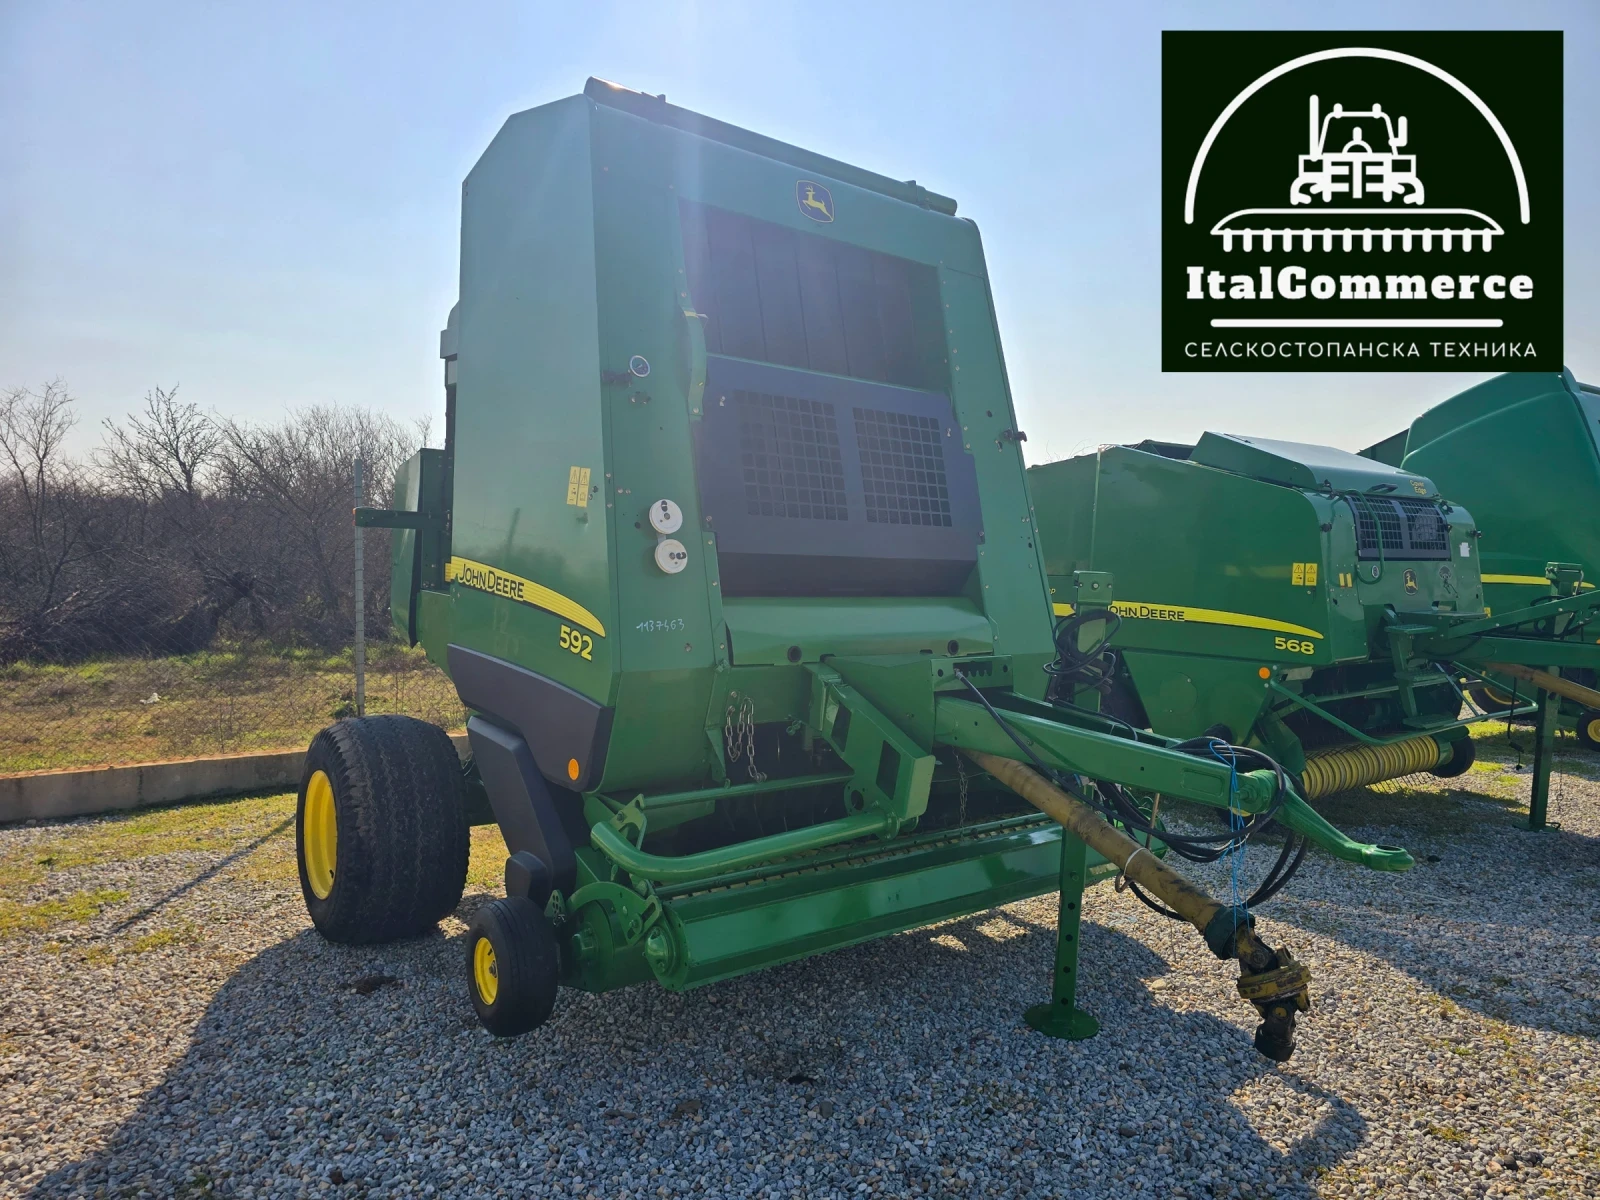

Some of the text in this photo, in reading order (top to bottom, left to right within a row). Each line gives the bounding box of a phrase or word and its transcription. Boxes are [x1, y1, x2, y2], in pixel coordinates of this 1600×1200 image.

[459, 563, 525, 599] JOHN DEERE
[1108, 605, 1185, 620] OHN DEERE
[559, 624, 593, 661] 592
[1274, 637, 1315, 655] 568
